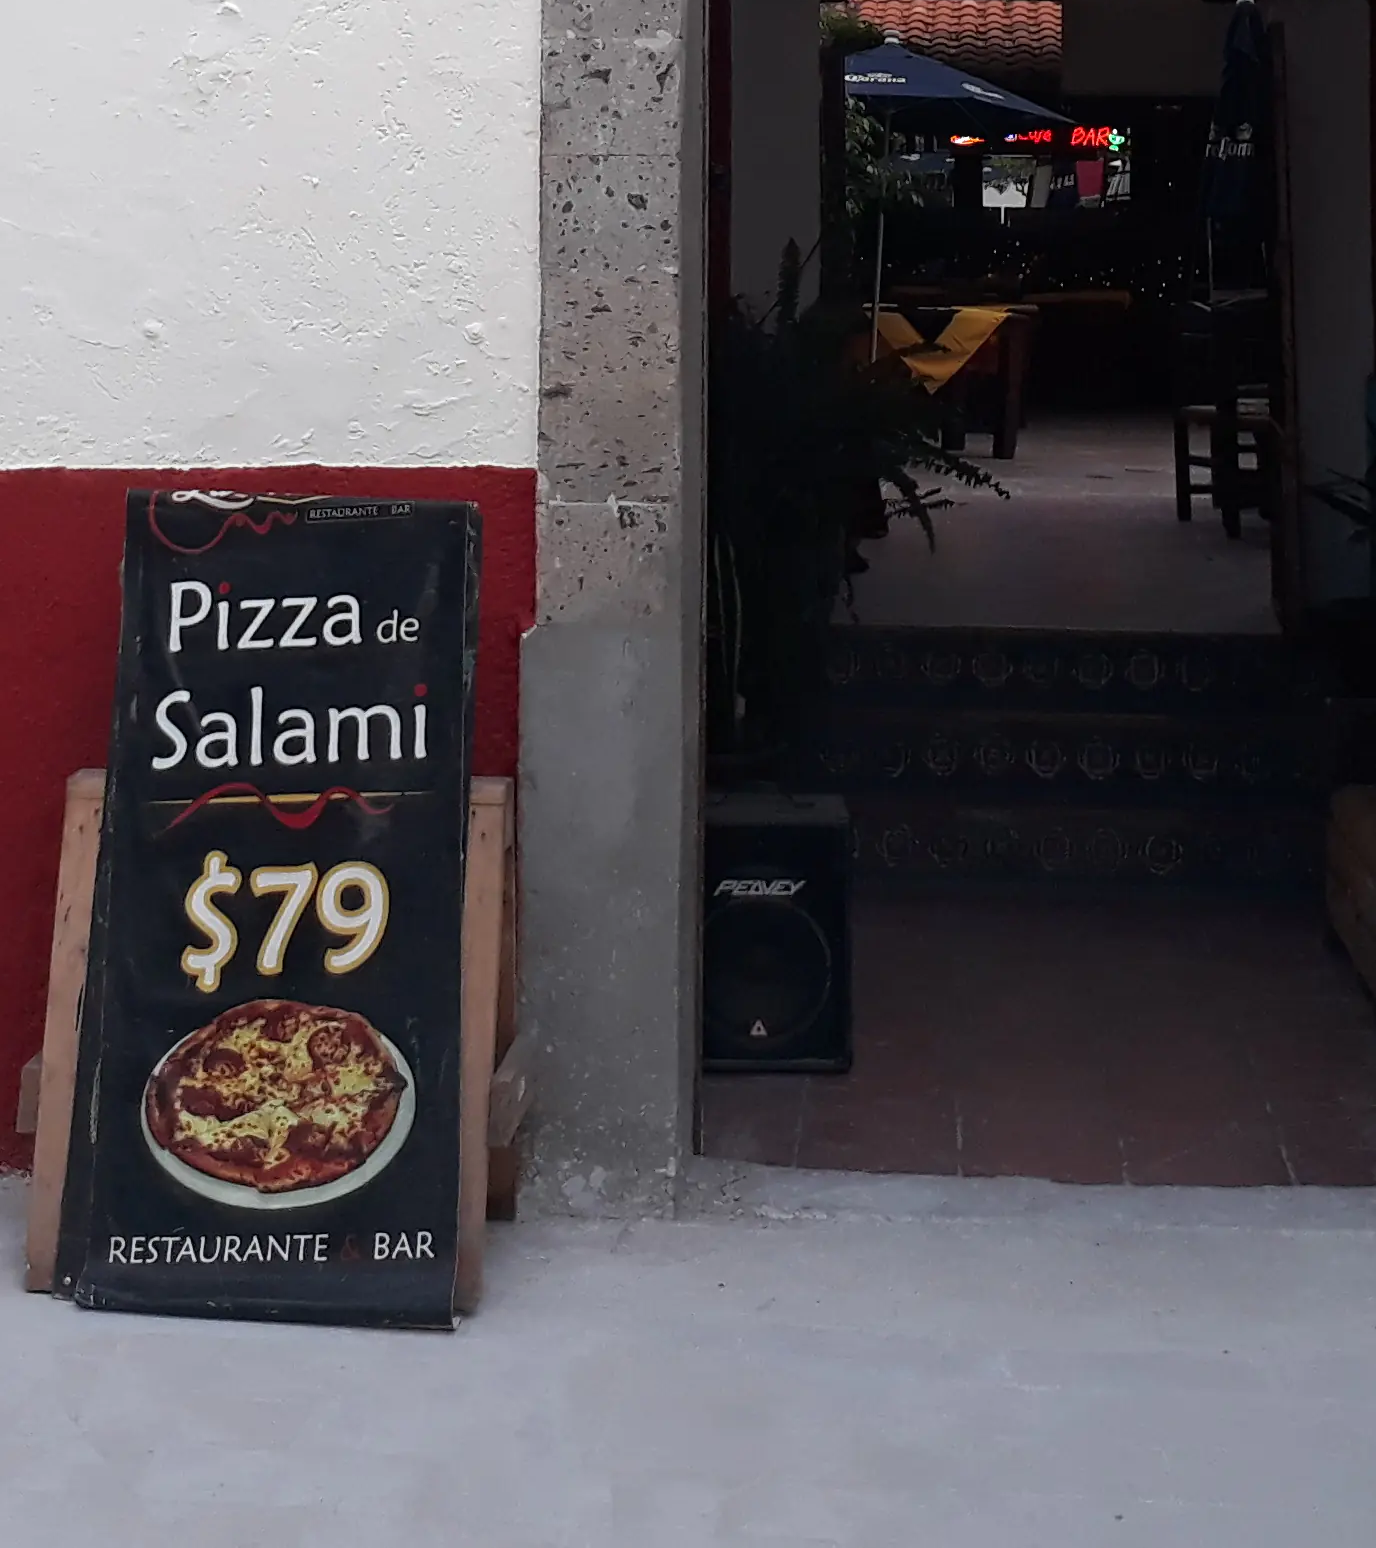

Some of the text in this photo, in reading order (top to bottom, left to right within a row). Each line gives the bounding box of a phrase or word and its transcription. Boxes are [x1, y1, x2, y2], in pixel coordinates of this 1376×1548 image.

[1070, 126, 1112, 146] BAR
[390, 504, 411, 515] BAR
[169, 580, 421, 653] Pizza de
[151, 682, 428, 771] Salami
[713, 879, 807, 896] PEAVEY
[180, 849, 390, 993] $79
[108, 1233, 329, 1265] RESTAURANTE
[373, 1230, 436, 1261] BAR
